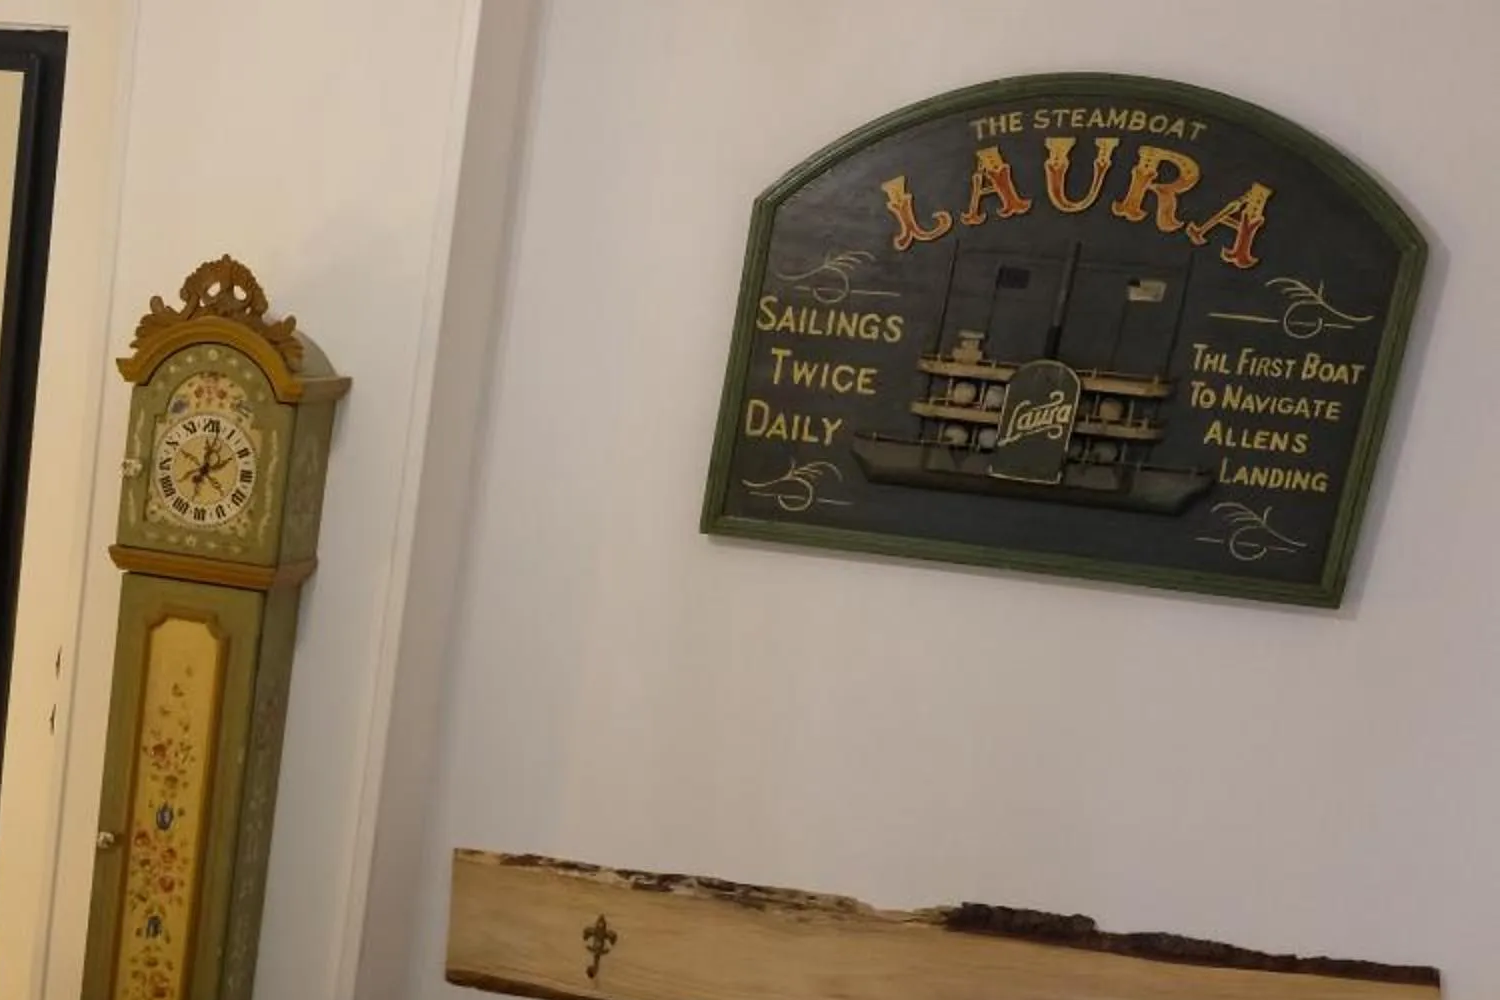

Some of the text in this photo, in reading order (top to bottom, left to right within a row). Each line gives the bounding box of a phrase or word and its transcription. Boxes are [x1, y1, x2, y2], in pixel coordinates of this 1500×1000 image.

[969, 107, 1208, 142] THE STEAMBOAT
[881, 137, 1274, 269] LAURA
[756, 295, 904, 343] SAILINGS
[771, 347, 878, 395] TWICE
[1236, 347, 1297, 380] FIRST
[1301, 352, 1365, 385] BOAT
[745, 399, 843, 446] DAILY
[997, 391, 1073, 447] Laura
[1190, 381, 1342, 422] TO NAVIGATE
[1203, 419, 1309, 454] ALLENS
[1219, 456, 1329, 493] LANDING
